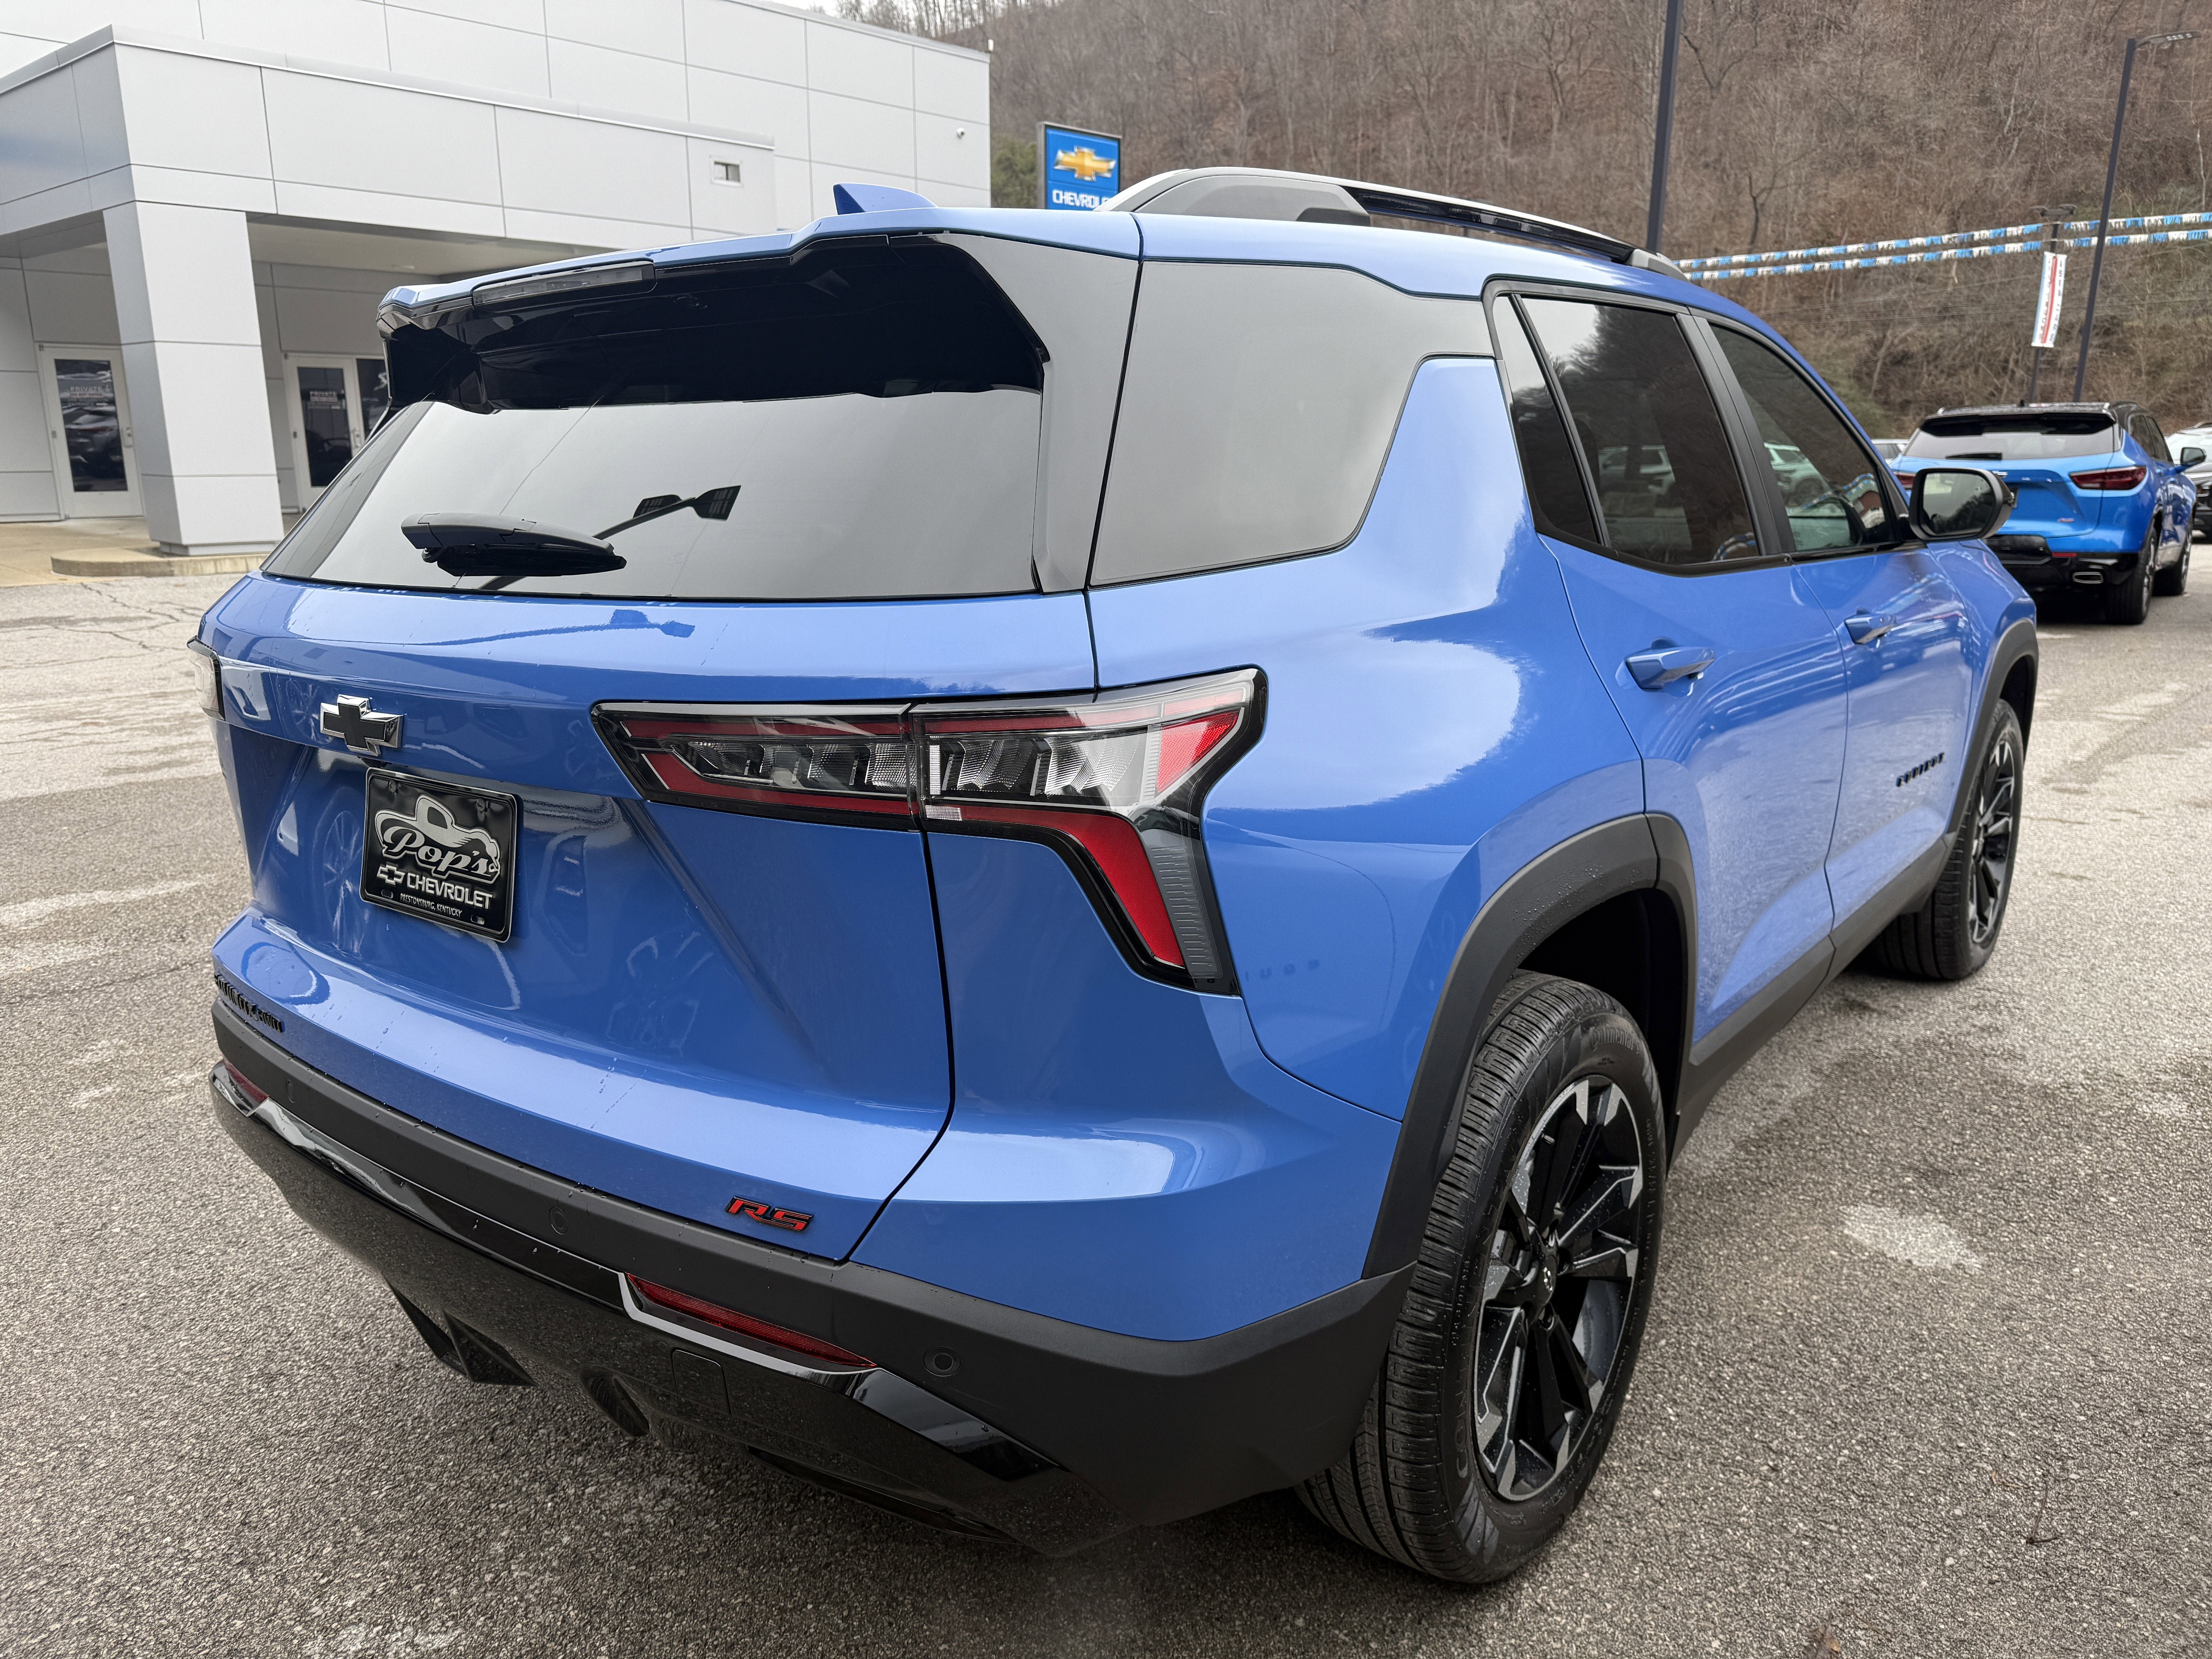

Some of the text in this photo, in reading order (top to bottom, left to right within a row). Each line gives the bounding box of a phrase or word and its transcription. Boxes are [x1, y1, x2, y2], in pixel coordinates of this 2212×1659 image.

[1052, 190, 1111, 208] CHEVROL
[383, 826, 491, 876] Pop's
[400, 893, 462, 917] PRESTONSBURG, KENTUCKY
[407, 873, 494, 909] CHEVROLET
[725, 1195, 814, 1232] RS
